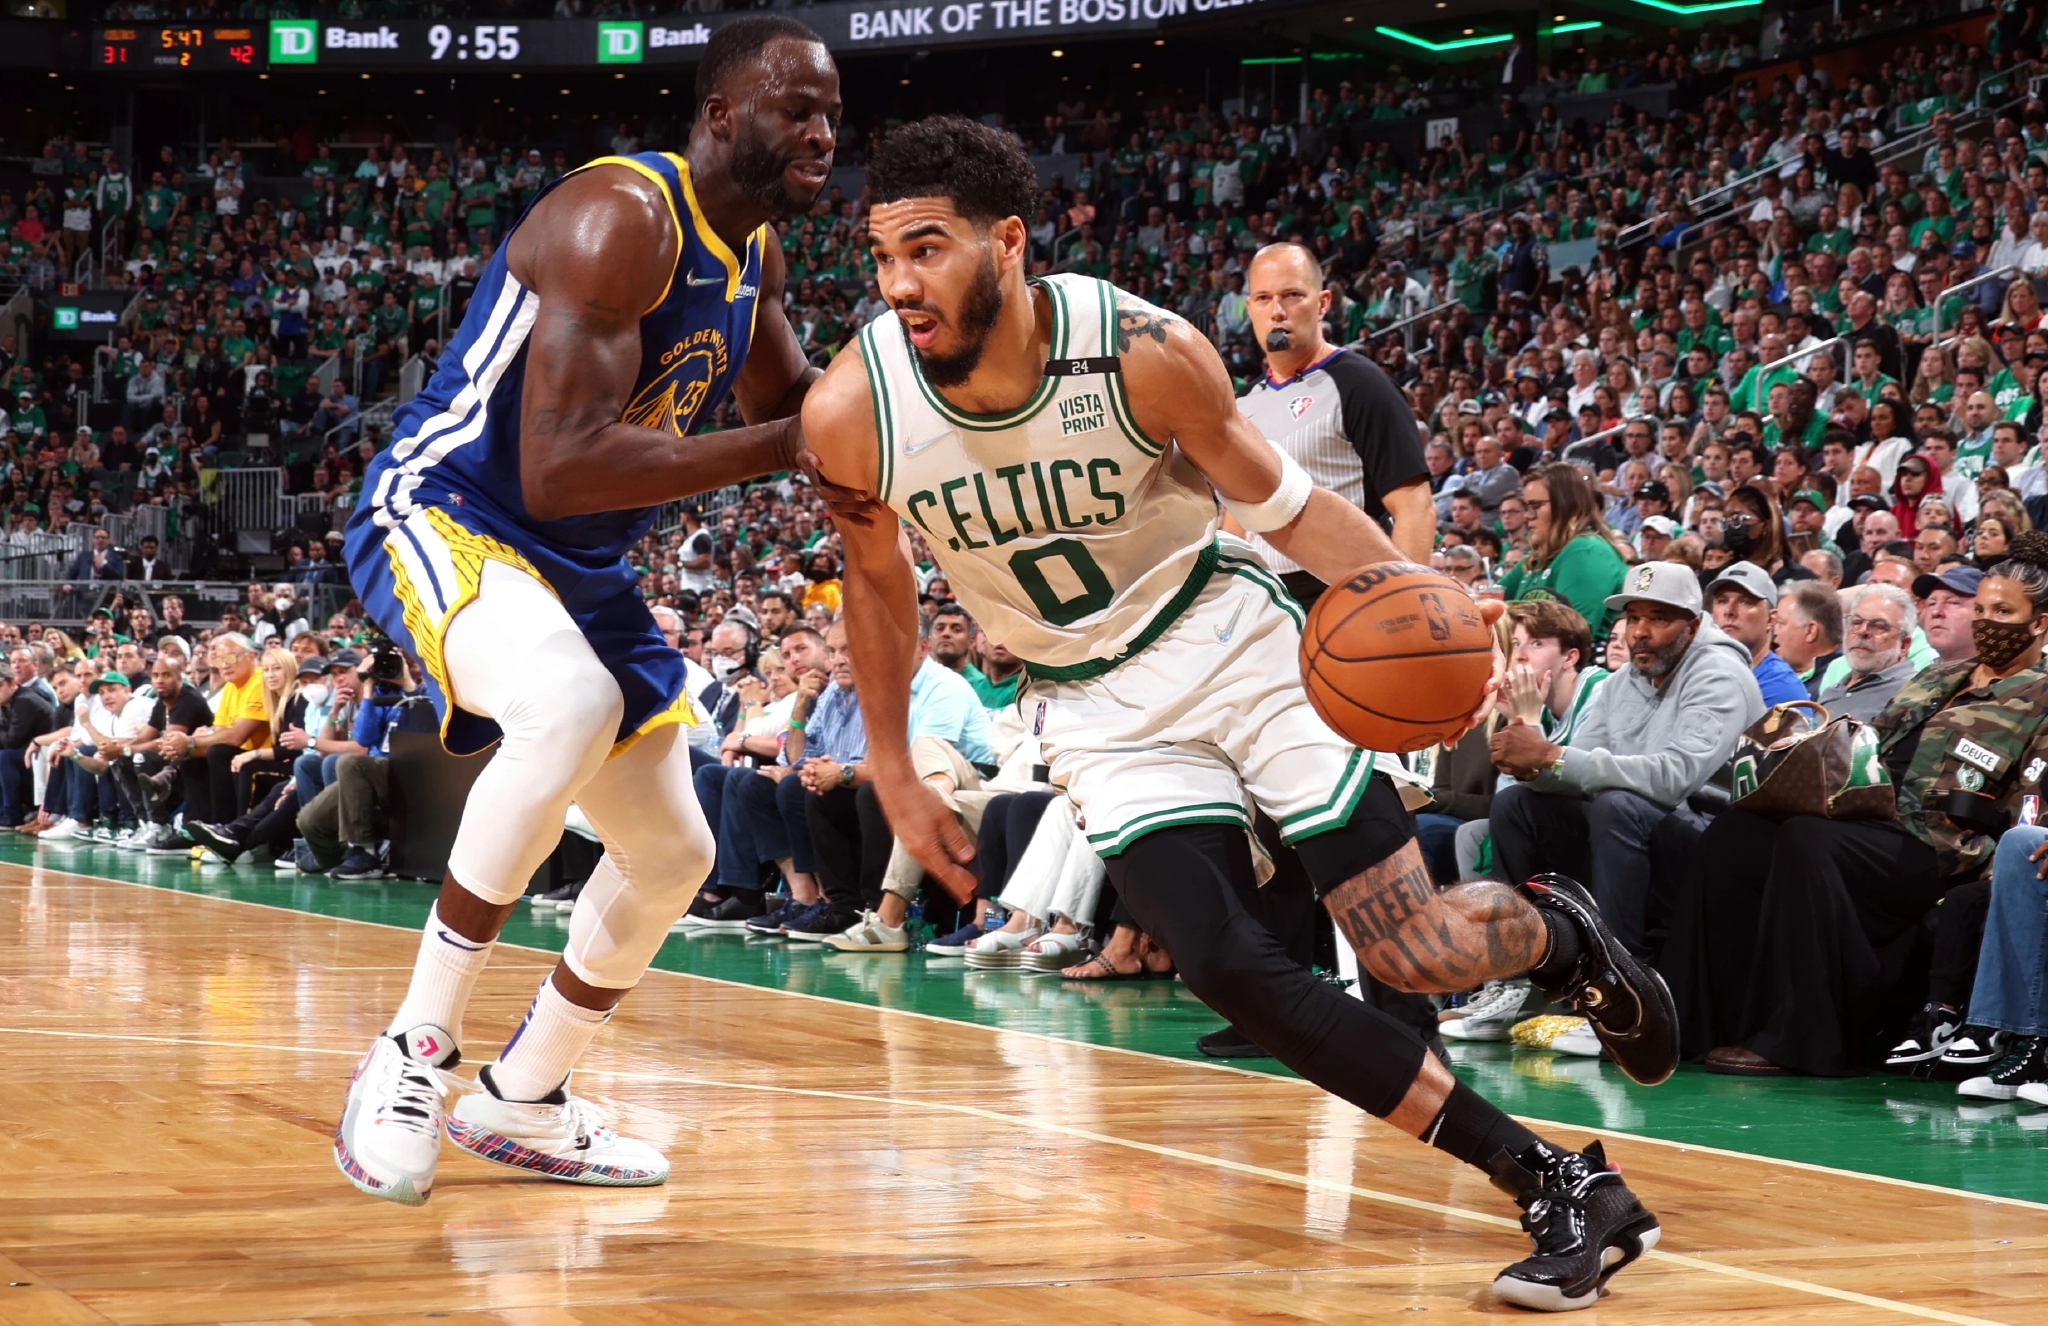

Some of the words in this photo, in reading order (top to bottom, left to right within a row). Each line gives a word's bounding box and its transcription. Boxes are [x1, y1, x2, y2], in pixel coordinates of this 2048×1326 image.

[850, 7, 933, 40] BANK
[941, 3, 983, 33] OF
[995, 1, 1052, 30] THE
[1060, 0, 1187, 25] BOSTON
[274, 27, 314, 55] TD
[325, 26, 399, 48] Bank
[428, 25, 520, 60] 9:55
[603, 28, 639, 55] TD
[650, 23, 711, 48] Bank
[104, 45, 128, 64] 31
[180, 52, 192, 66] 2
[229, 45, 254, 64] 42
[57, 310, 78, 325] TD
[81, 310, 117, 322] Bank
[659, 328, 720, 366] GOLDEN
[1071, 360, 1089, 374] 24
[674, 380, 708, 415] 23
[1058, 394, 1104, 419] VISTA
[1062, 413, 1105, 435] PRINT
[906, 457, 1125, 552] CELTICS
[1008, 537, 1115, 627] 0
[1960, 744, 1995, 766] DEUCE
